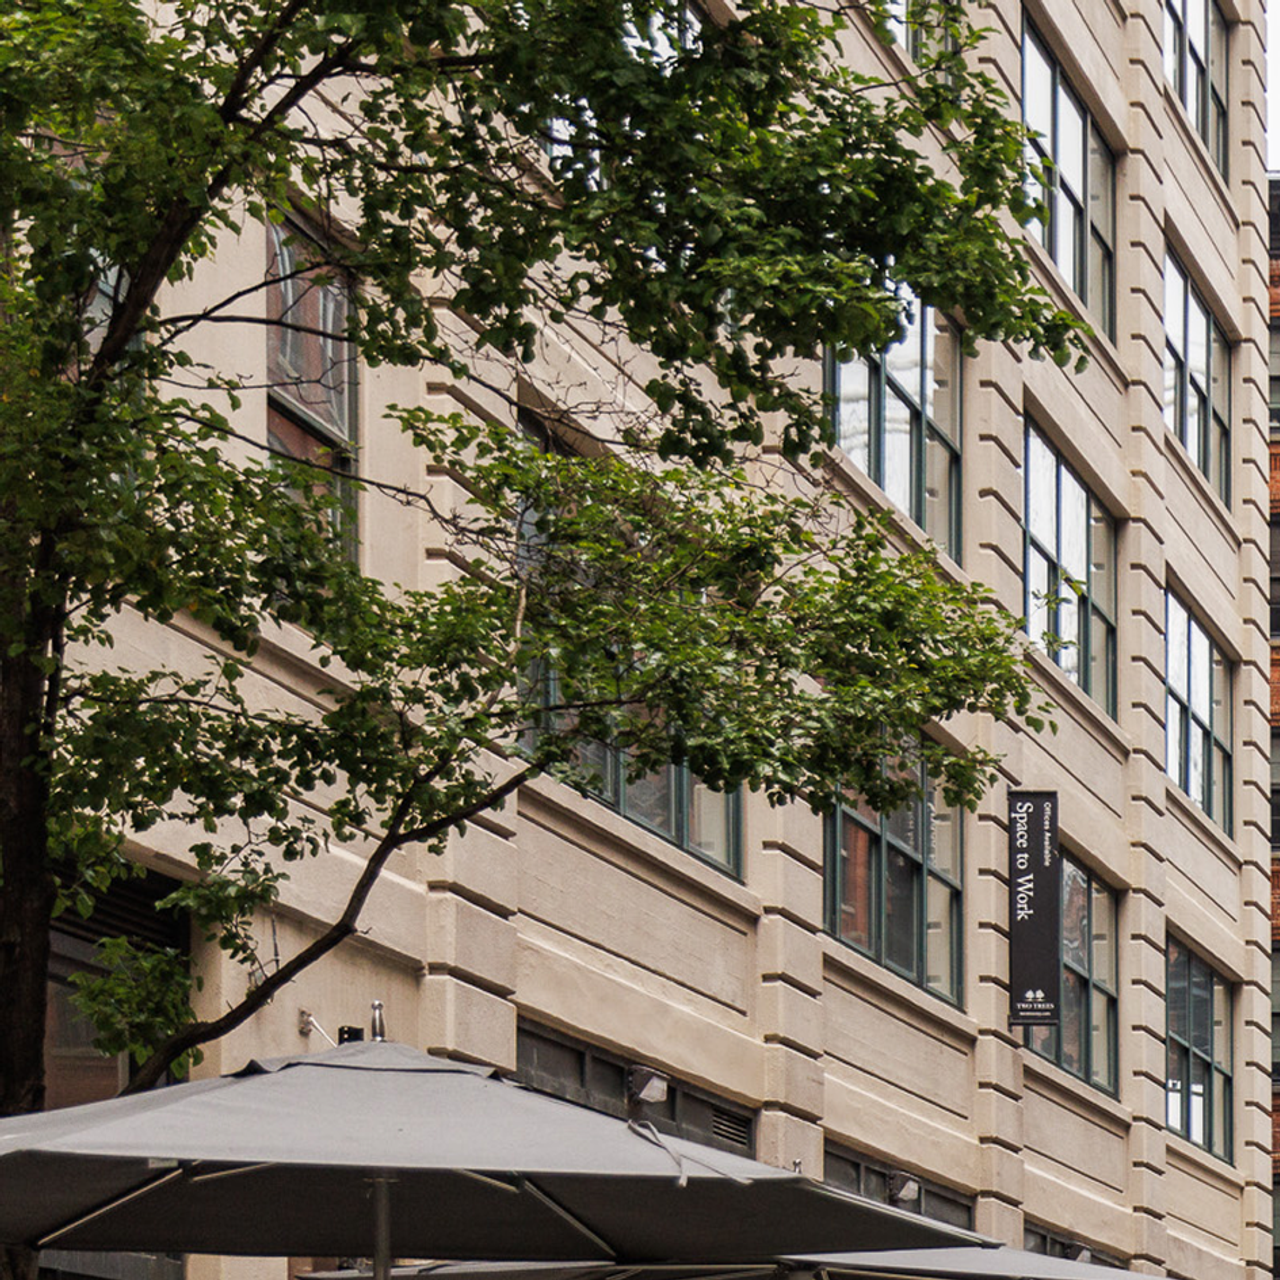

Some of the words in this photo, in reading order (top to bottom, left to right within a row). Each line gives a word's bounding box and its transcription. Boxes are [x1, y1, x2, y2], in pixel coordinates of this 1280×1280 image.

[1011, 801, 1034, 848] Space
[1043, 801, 1052, 829] Offices
[1016, 852, 1029, 869] to
[1043, 831, 1052, 867] Available
[1016, 873, 1034, 921] Work
